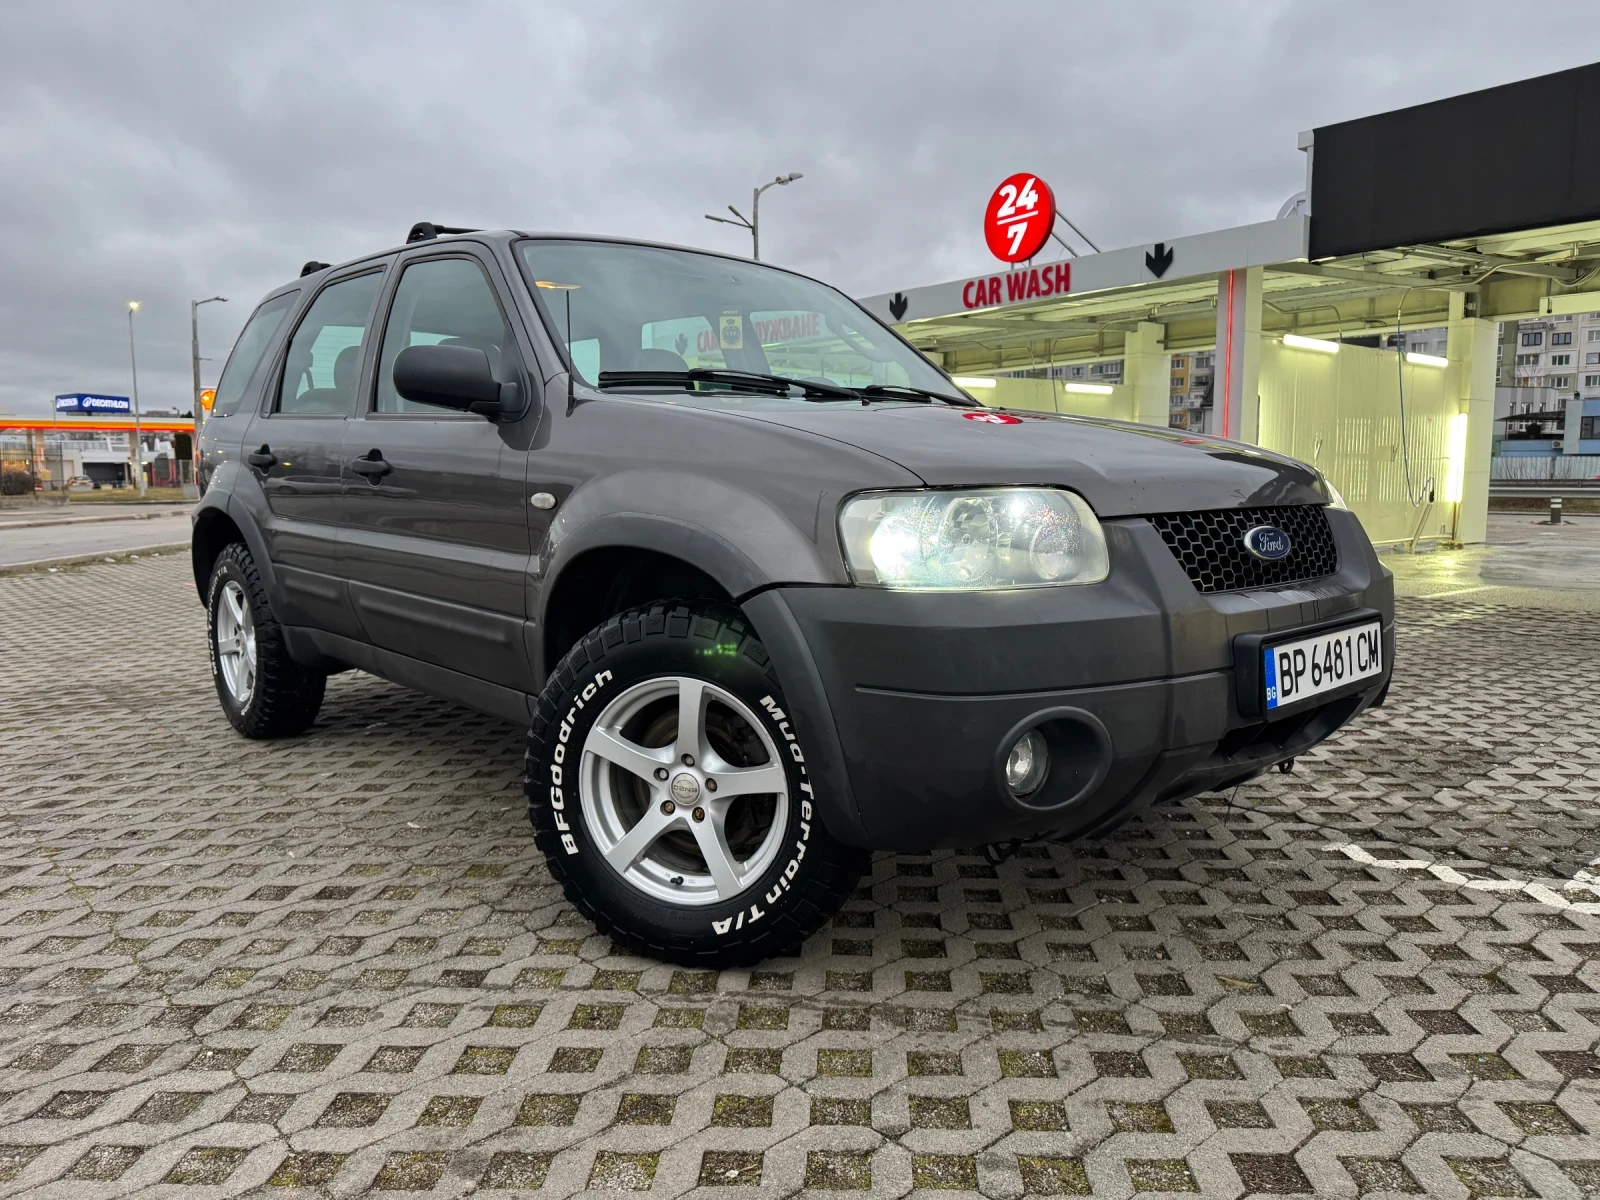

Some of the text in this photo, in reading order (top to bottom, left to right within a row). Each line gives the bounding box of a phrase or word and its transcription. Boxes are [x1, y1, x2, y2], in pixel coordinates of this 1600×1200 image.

[997, 178, 1039, 218] 24
[1007, 221, 1028, 256] 7
[963, 263, 1070, 308] CAR WASH
[1259, 532, 1284, 552] Ford
[1278, 629, 1379, 698] BP 6481 CM
[1266, 686, 1277, 700] BG
[711, 904, 765, 935] T/A
